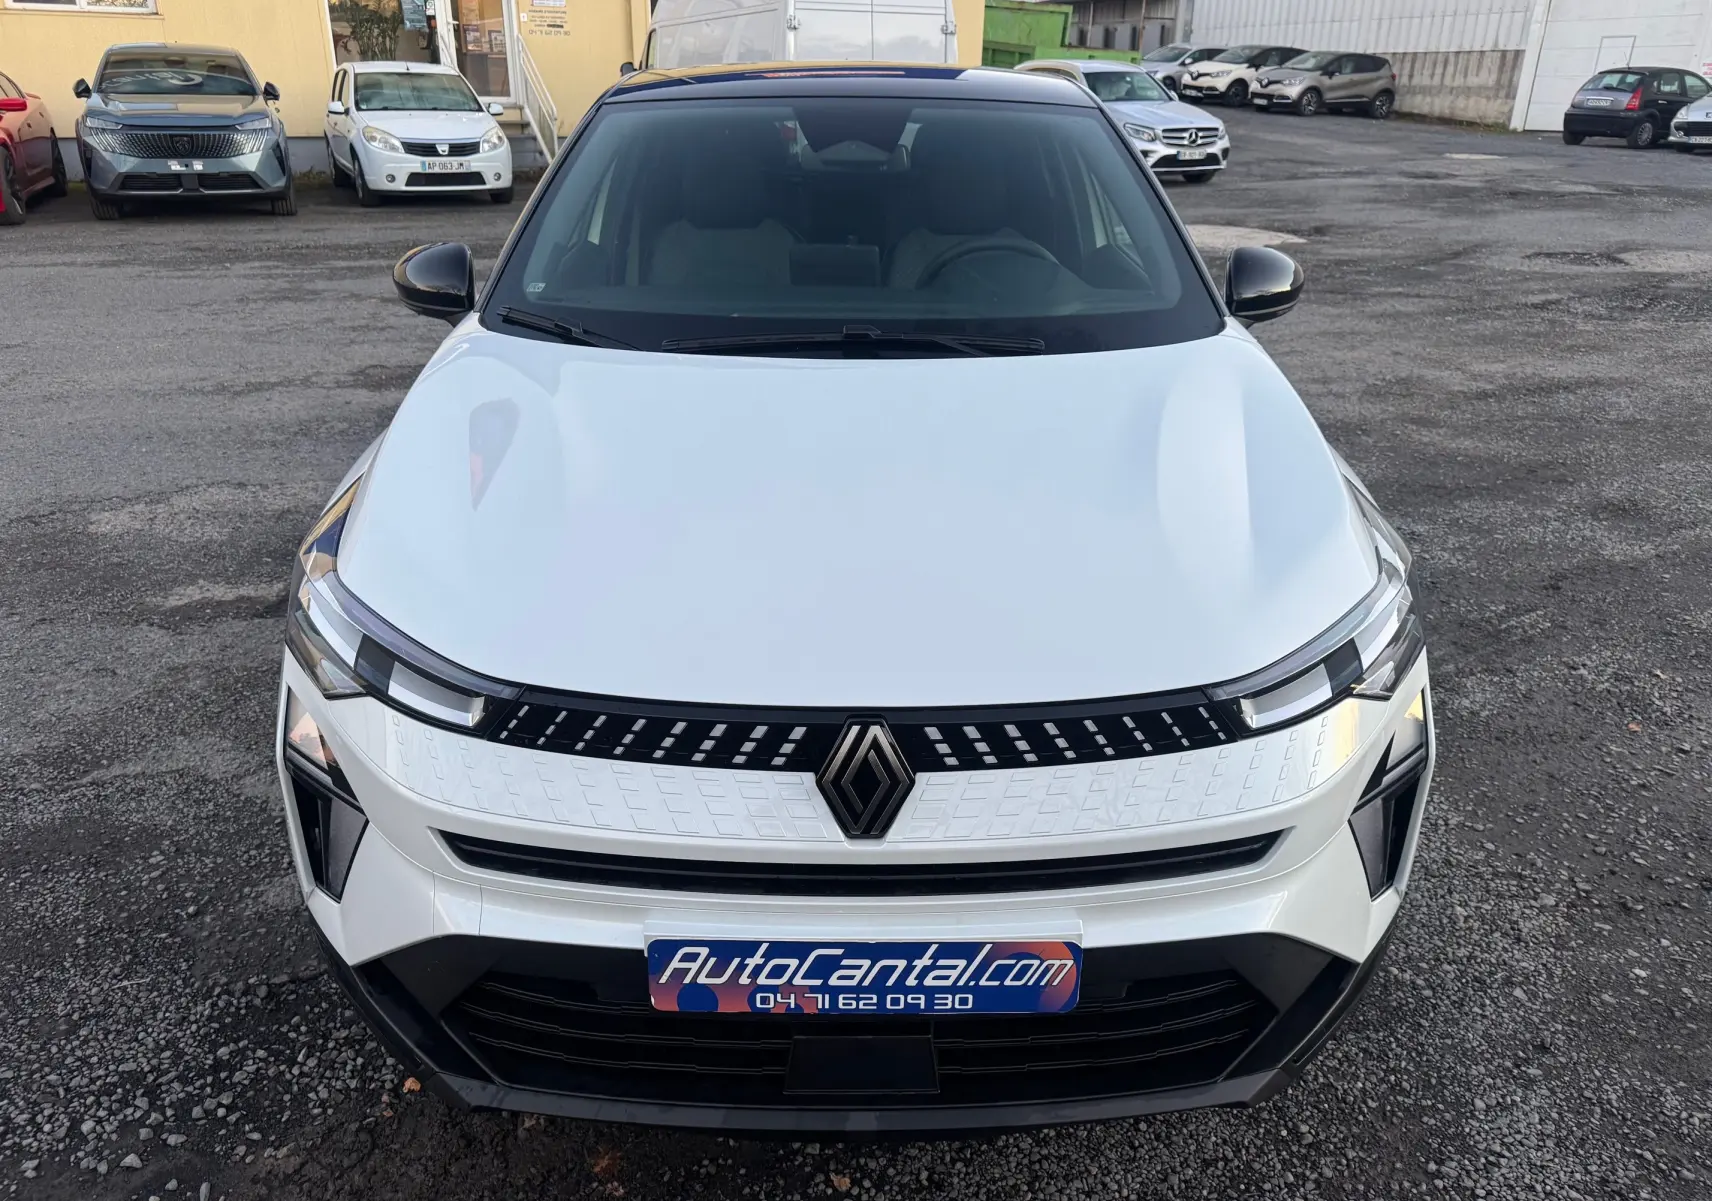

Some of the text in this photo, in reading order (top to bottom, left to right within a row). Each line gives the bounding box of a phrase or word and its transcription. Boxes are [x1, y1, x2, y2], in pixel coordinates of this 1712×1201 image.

[658, 942, 1075, 987] AutoCantal.com
[755, 993, 973, 1010] 04 71 62 09 30
